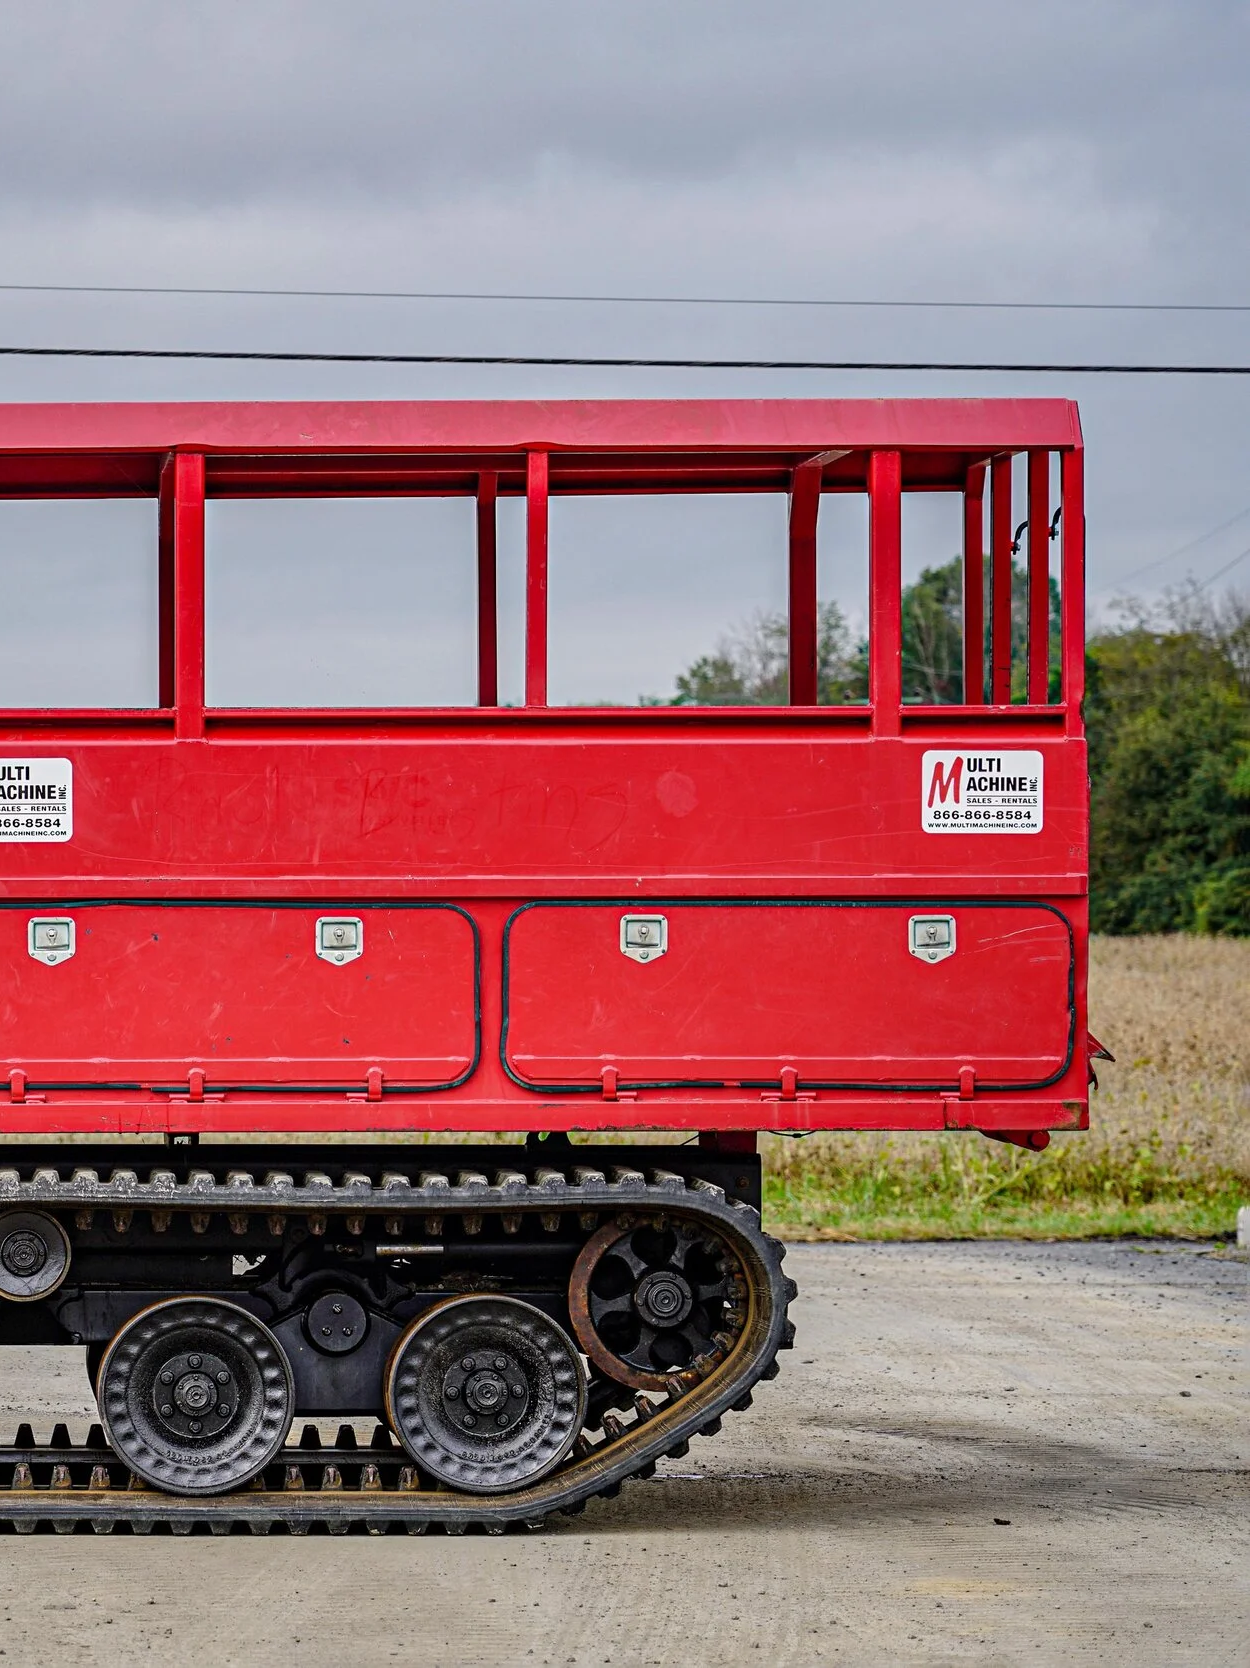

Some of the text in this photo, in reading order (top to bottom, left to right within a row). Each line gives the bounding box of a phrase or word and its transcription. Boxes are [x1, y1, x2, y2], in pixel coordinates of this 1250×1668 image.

[58, 784, 67, 799] INC.
[1029, 776, 1038, 792] INC.
[933, 810, 1032, 820] 866-866-8584
